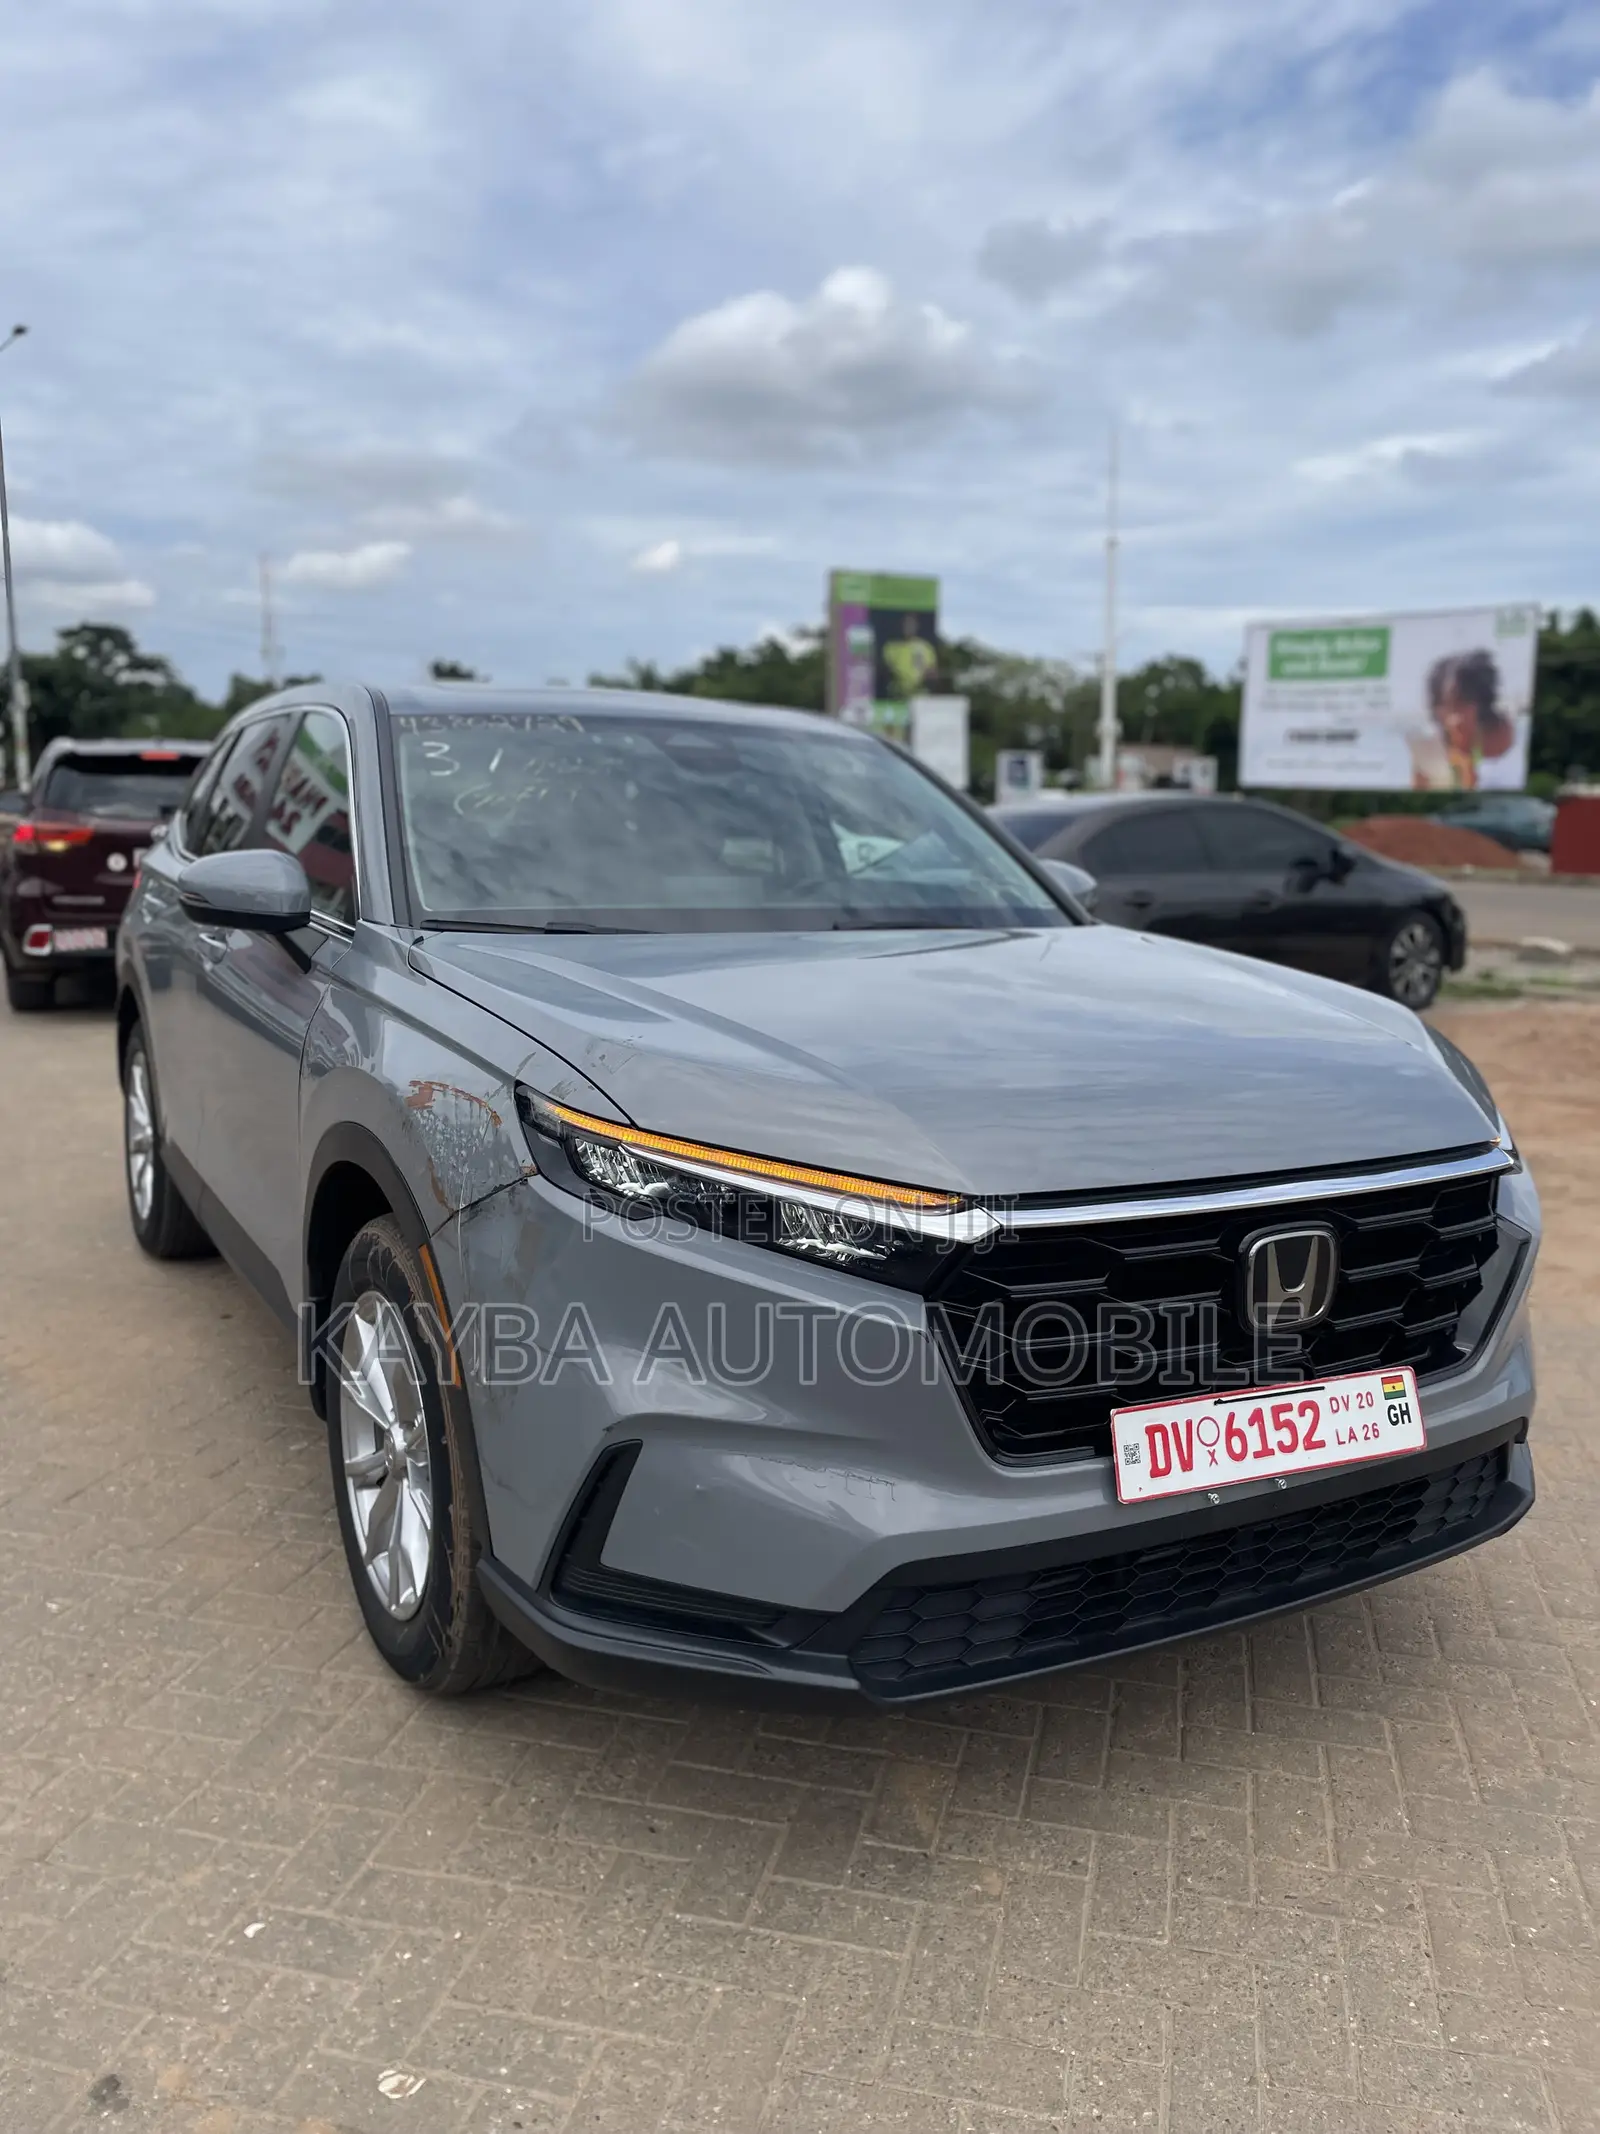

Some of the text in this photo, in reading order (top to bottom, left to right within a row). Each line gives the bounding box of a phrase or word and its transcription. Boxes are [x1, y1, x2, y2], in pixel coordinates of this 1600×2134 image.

[421, 740, 461, 777] 3
[1329, 1391, 1374, 1415] DV 20
[1387, 1402, 1412, 1427] GH
[1144, 1418, 1194, 1479] DV
[1225, 1400, 1326, 1462] 6152
[1335, 1422, 1380, 1446] LA 26
